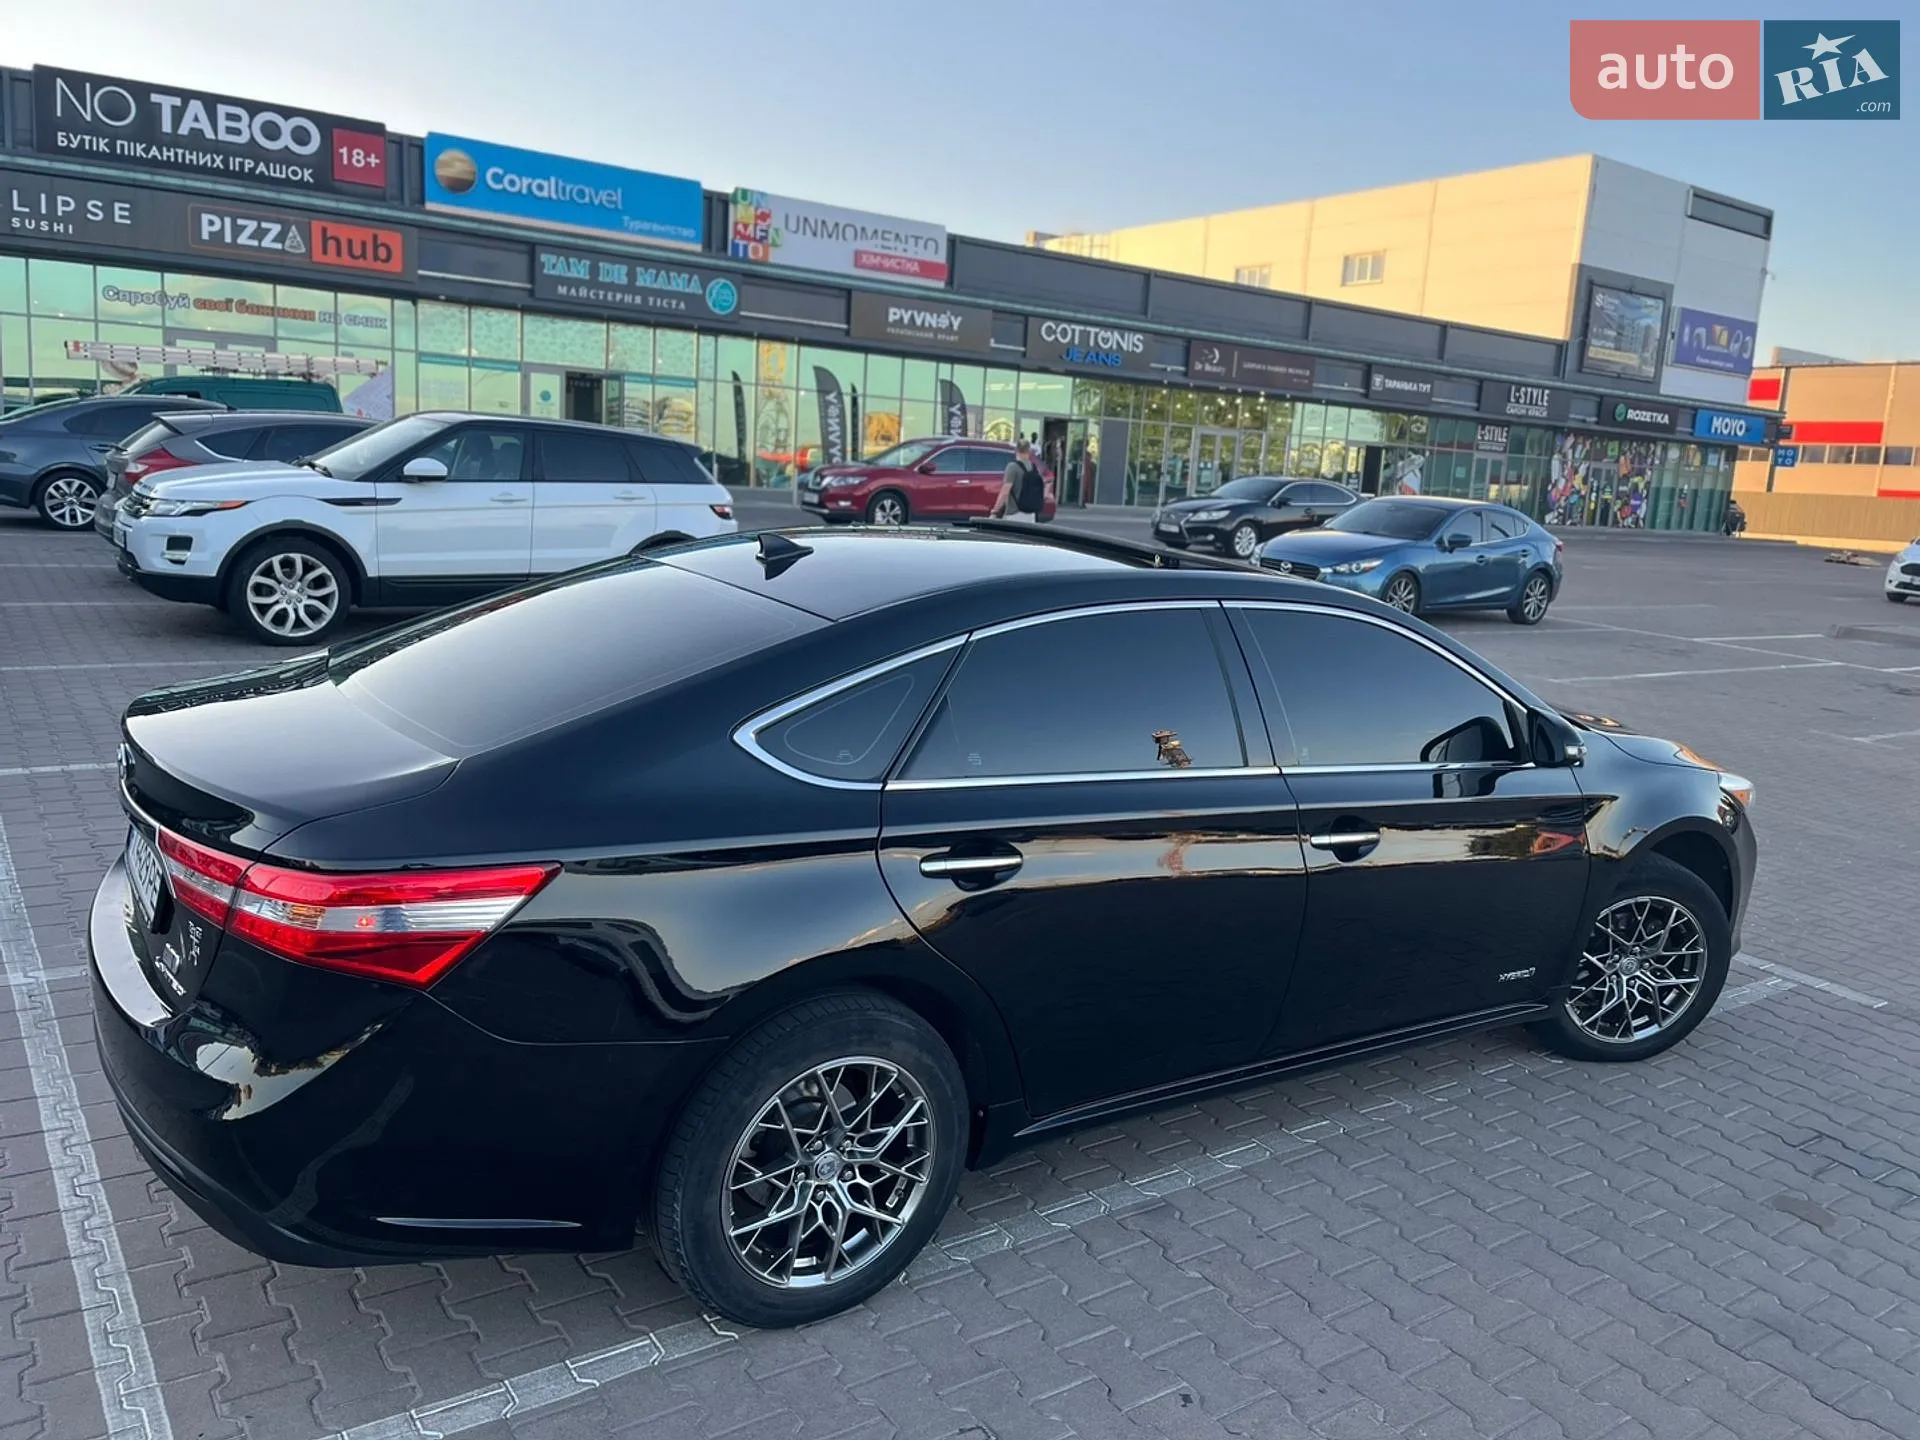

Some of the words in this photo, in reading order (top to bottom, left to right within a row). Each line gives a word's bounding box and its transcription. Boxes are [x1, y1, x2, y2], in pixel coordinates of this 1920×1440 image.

[56, 77, 136, 127] NO
[150, 92, 321, 155] TABOO
[57, 131, 109, 153] БУТІК
[116, 139, 224, 170] ПІКАНТНИХ
[229, 155, 315, 184] ІГРАШОК
[338, 146, 380, 168] 18+
[0, 189, 132, 224] LIPSE
[11, 216, 74, 235] SUSHI
[784, 212, 940, 256] UNMOMENTO
[321, 226, 393, 264] hub
[103, 285, 190, 309] Спробуй
[557, 285, 642, 304] МАЙСТЕРНЯ
[648, 297, 686, 310] ТІСТА
[1062, 347, 1122, 368] JEANS
[1626, 411, 1669, 425] ROZETKA
[1711, 416, 1746, 437] MOYO
